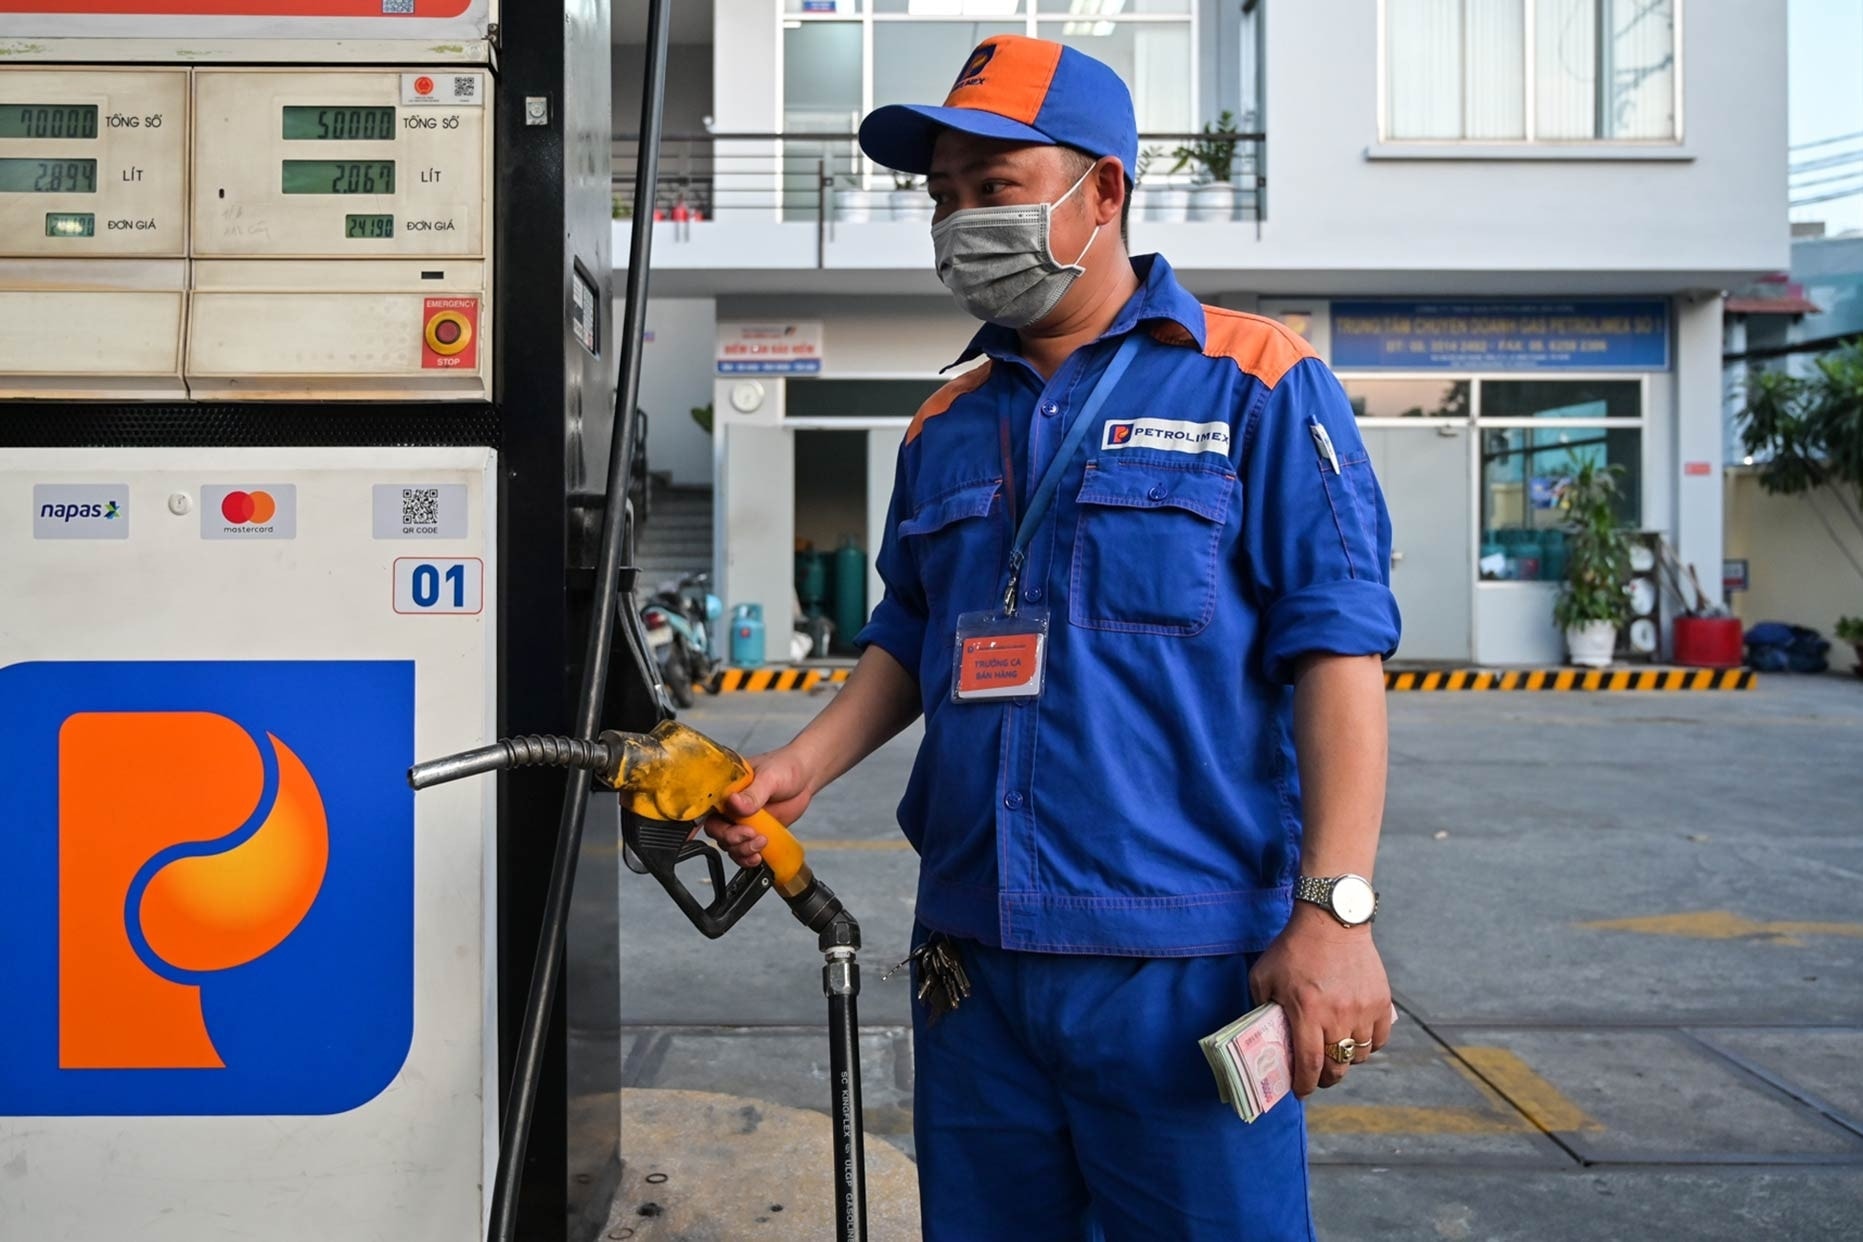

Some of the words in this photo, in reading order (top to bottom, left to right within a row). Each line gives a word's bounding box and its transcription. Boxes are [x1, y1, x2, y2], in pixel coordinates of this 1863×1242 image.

[20, 109, 95, 137] 70000
[105, 113, 140, 128] TỔNG
[144, 114, 163, 128] SỐ
[317, 110, 392, 139] 50000
[402, 114, 438, 129] TỔNG
[442, 115, 460, 129] SỐ
[34, 163, 94, 191] 2.894
[122, 166, 144, 182] LÍT
[331, 165, 392, 193] 2.067
[420, 168, 441, 183] LÍT
[107, 219, 133, 230] ĐƠN
[135, 218, 156, 230] GIÁ
[349, 218, 394, 237] 24190
[406, 220, 432, 231] ĐƠN
[434, 219, 456, 231] GIÁ
[426, 300, 476, 308] EMERGENCY
[437, 358, 460, 366] STOP
[1134, 427, 1229, 445] PETROLIMEX
[40, 504, 102, 522] napas
[223, 526, 274, 534] mastercard
[412, 564, 464, 607] 01
[840, 1071, 849, 1085] SC
[841, 1090, 850, 1138] KINGFLEX
[844, 1159, 853, 1187] ULGP
